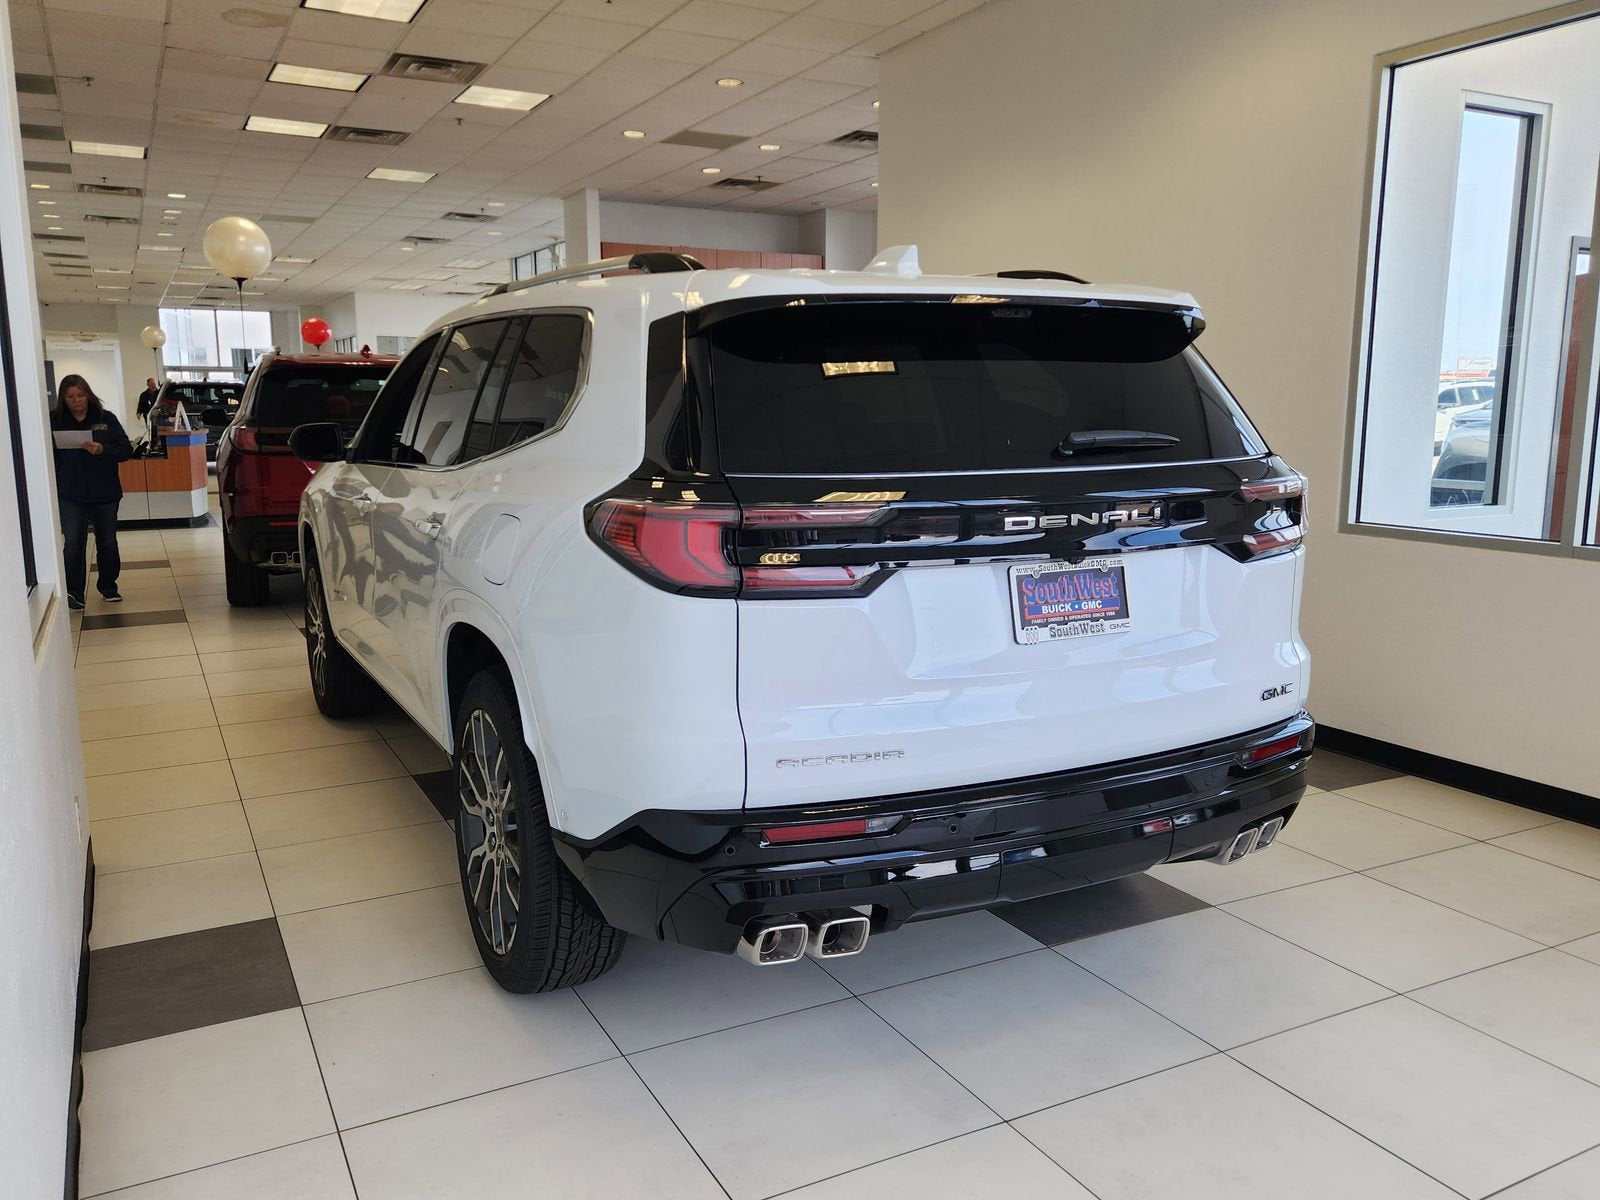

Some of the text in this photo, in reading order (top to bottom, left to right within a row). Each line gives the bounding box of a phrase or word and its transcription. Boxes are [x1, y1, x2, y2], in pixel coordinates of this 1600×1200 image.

[1004, 506, 1161, 531] DENALI
[1022, 573, 1119, 605] SouthWest
[1041, 600, 1103, 614] BUICK GMC
[1050, 622, 1105, 639] SouthWest
[1109, 622, 1131, 630] GMC
[1261, 682, 1294, 701] GMC
[776, 750, 905, 769] ACADIA
